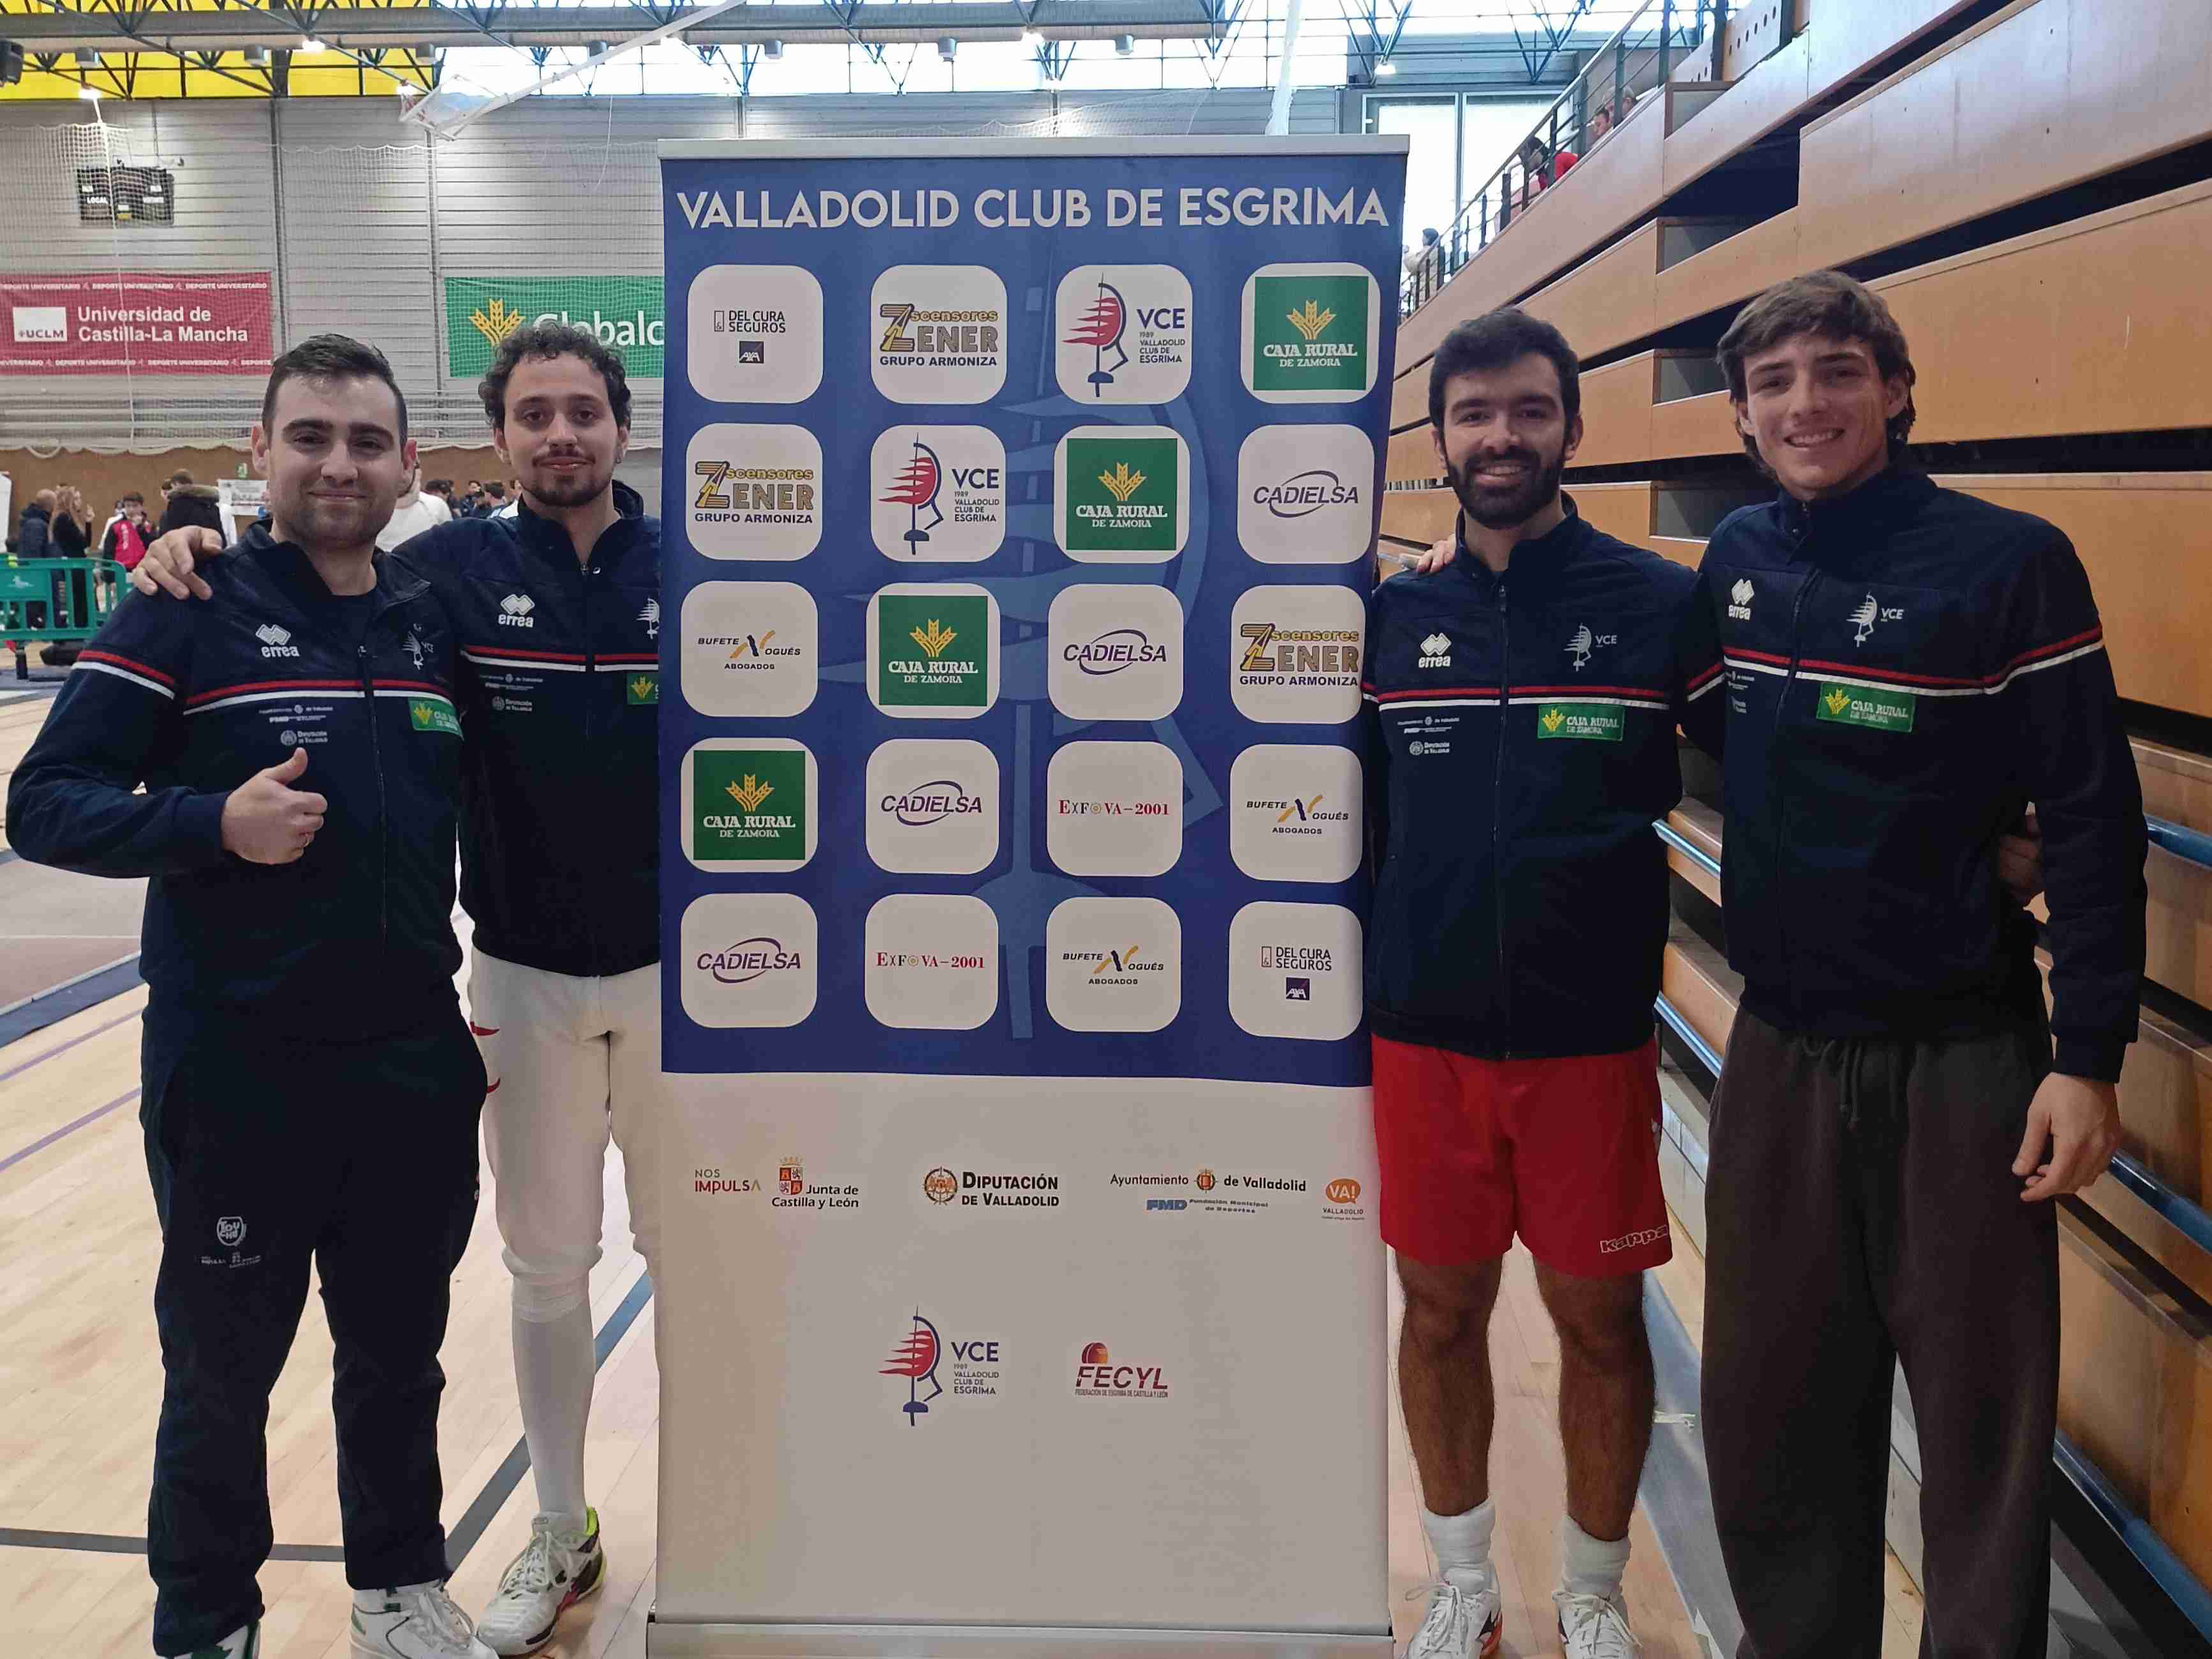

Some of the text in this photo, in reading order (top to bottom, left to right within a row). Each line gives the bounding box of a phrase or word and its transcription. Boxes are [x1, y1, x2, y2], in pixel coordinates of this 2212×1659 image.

[677, 186, 1389, 229] VALLADOLID CLUB DE ESGRIMA
[78, 306, 211, 322] Universidad de
[728, 310, 785, 322] DEL CURA
[1137, 308, 1185, 329] VCE
[728, 321, 786, 333] SEGUROS
[78, 326, 248, 343] Castilla-La Mancha
[1263, 343, 1357, 357] CAJA RURAL
[739, 351, 760, 362] AXA
[880, 356, 997, 366] GRUPO ARMONIZA
[1139, 355, 1183, 363] ESGRIMA
[1279, 357, 1341, 367] DE ZAMORA
[951, 468, 999, 489] VCE
[1253, 485, 1359, 505] CADIELSA
[954, 513, 996, 522] ESGRIMA
[1075, 505, 1168, 518] CAJA RURAL
[695, 512, 813, 524] GRUPO ARMONIZA
[1092, 519, 1152, 528] DE ZAMORA
[1881, 607, 1904, 619] VCE
[498, 614, 534, 628] errea
[697, 637, 740, 645] BUFETE
[1595, 635, 1618, 645] VCE
[1063, 644, 1167, 663] CADIELSA
[888, 661, 978, 674] CAJA RURAL
[1418, 656, 1451, 668] errea
[904, 675, 963, 684] DE ZAMORA
[1239, 675, 1359, 686] GRUPO ARMONIZA
[880, 795, 983, 814] CADIELSA
[1246, 800, 1287, 809] BUFETE
[703, 815, 796, 829] CAJA RURAL
[719, 830, 780, 838] DE ZAMORA
[1063, 952, 1103, 961] BUFETE
[1276, 947, 1332, 961] DEL CURA
[697, 952, 802, 970] CADIELSA
[1276, 958, 1332, 971] SEGUROS
[1286, 988, 1307, 999] AXA
[695, 1169, 720, 1178] NOS
[962, 1171, 1058, 1190] DIPUTACIÓN
[1110, 1173, 1306, 1192] Ayuntamiento de Valladolid
[806, 1184, 859, 1195] Junta de
[771, 1197, 859, 1209] Castilla y León
[962, 1192, 1059, 1207] DE VALLADOLID
[951, 1341, 999, 1362] VCE
[1075, 1366, 1168, 1389] FECYL
[954, 1386, 996, 1394] ESGRIMA
